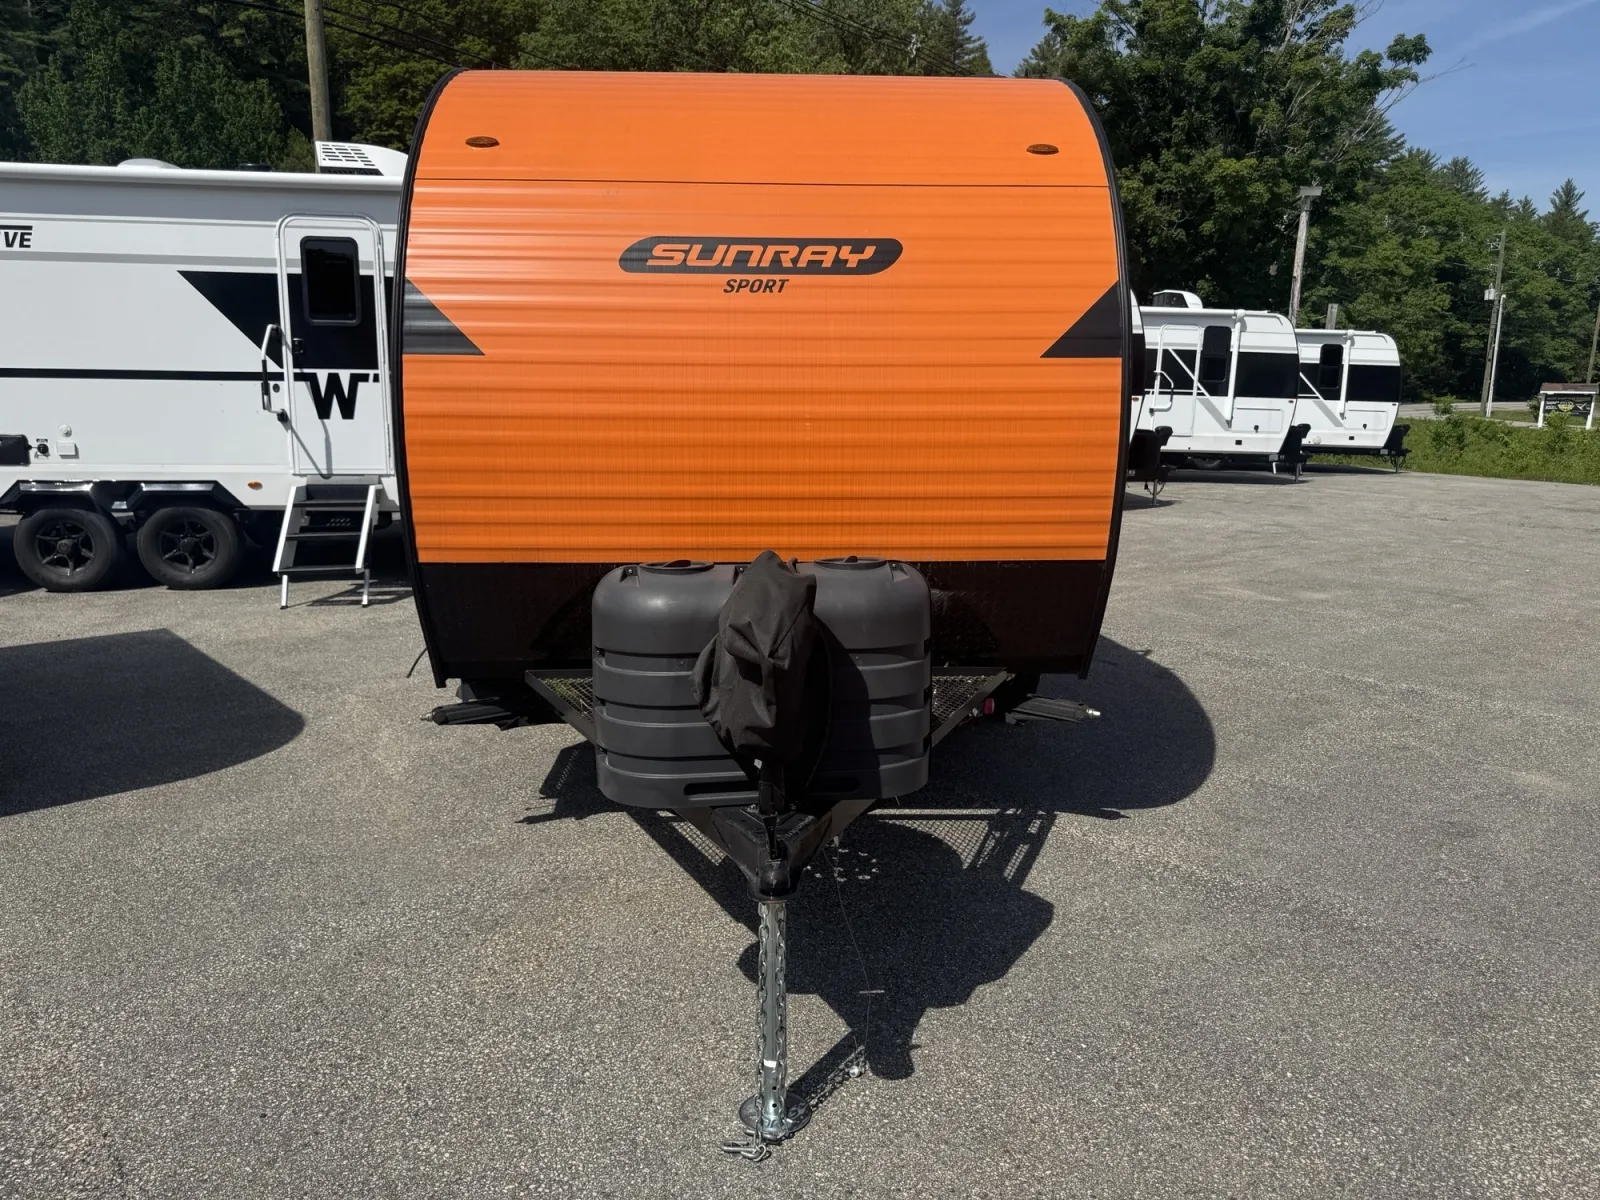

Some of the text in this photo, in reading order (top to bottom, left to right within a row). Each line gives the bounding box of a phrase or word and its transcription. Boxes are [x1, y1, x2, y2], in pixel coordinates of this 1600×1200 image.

[646, 243, 876, 267] SUNRAY
[723, 278, 790, 293] SPORT
[304, 372, 368, 420] W
